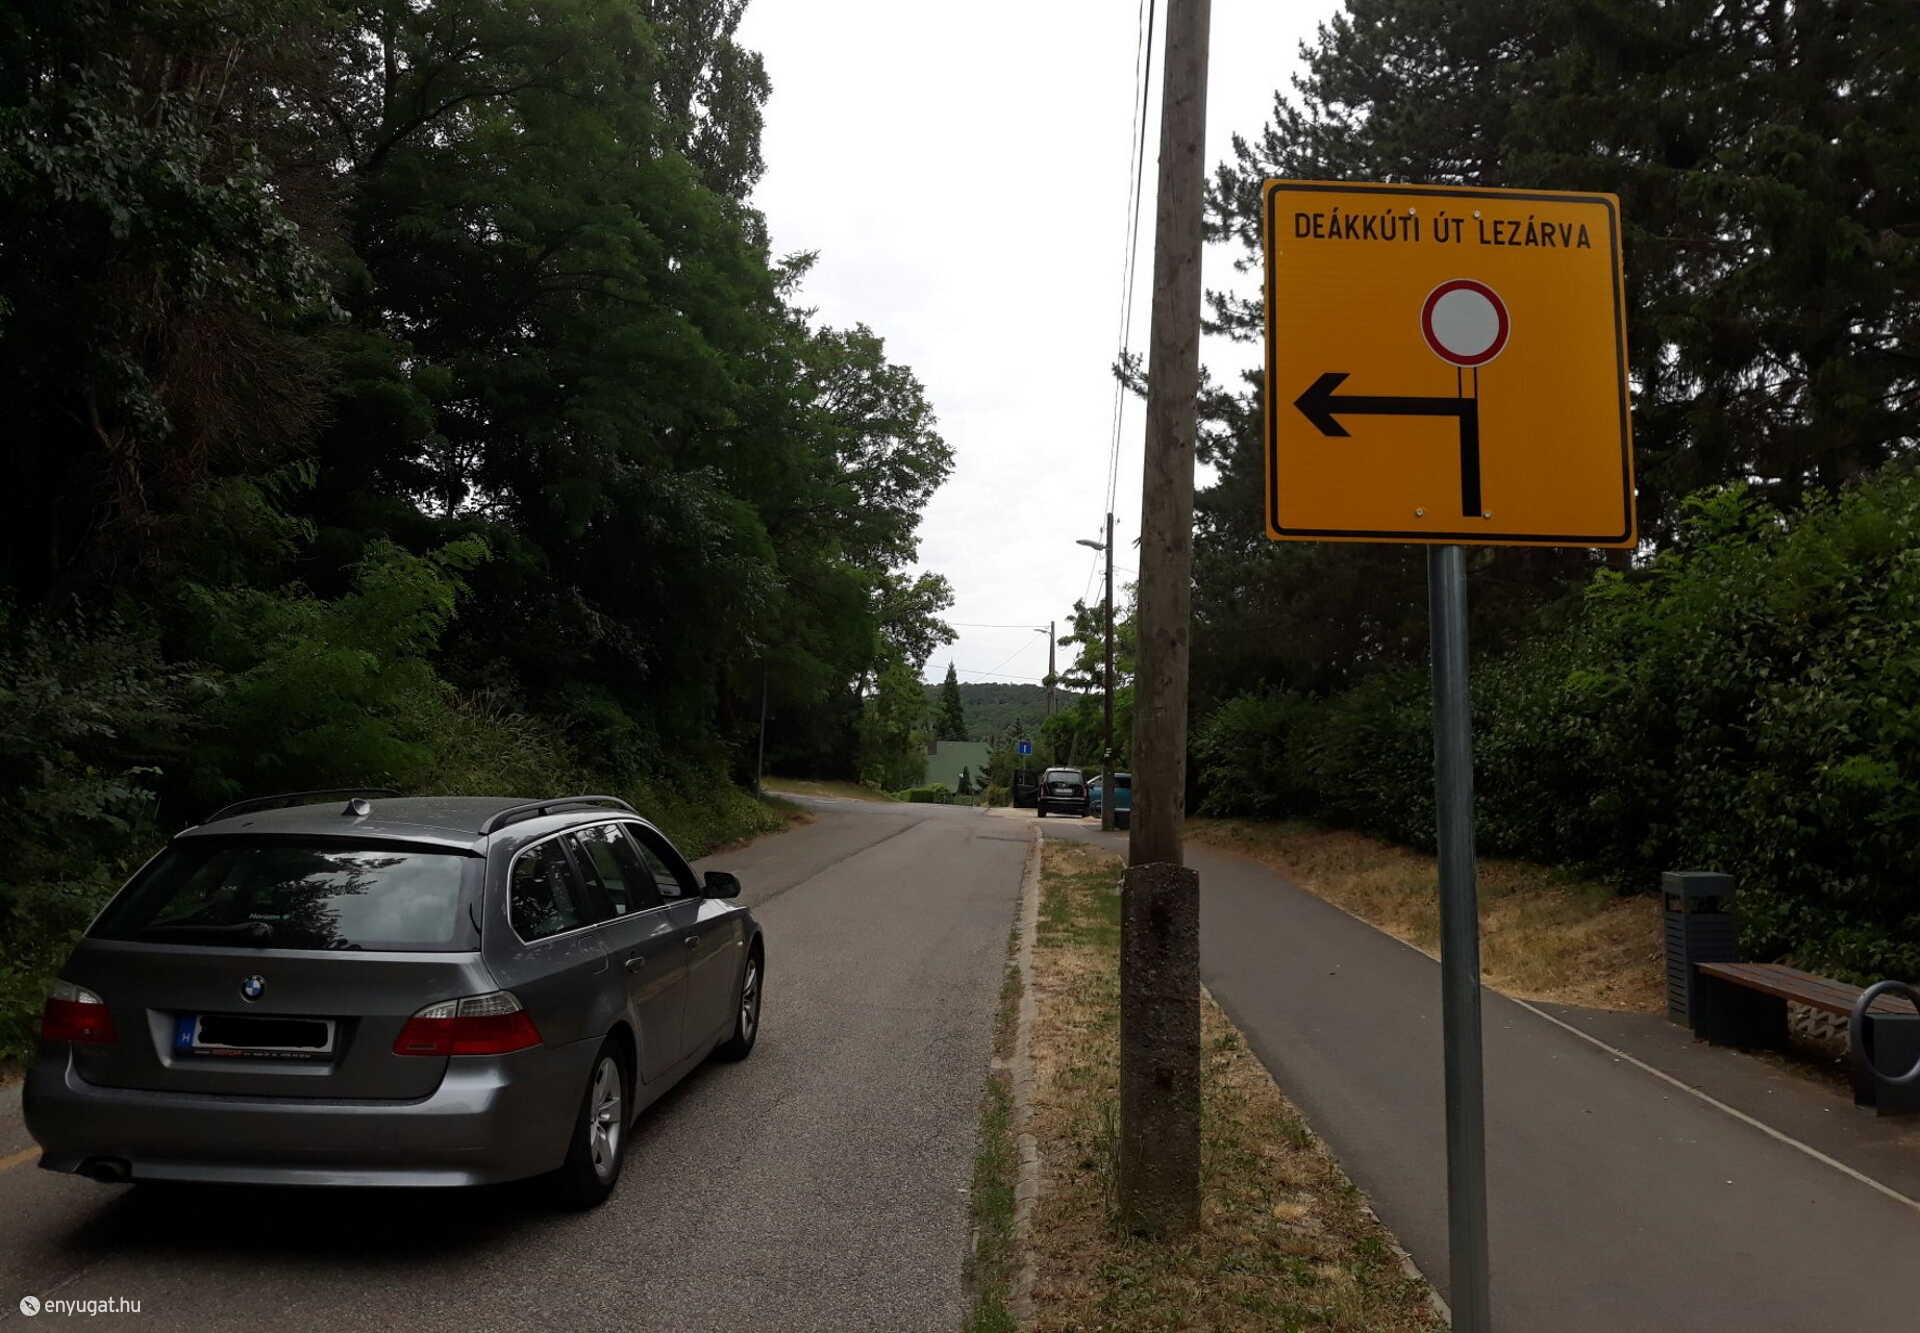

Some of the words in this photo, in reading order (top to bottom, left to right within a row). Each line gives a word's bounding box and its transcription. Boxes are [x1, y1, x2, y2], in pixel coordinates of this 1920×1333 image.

[1294, 207, 1420, 242] DEÁKKÚTI
[1433, 211, 1465, 243] ÚT
[1478, 215, 1591, 249] LEZÁRVA
[181, 1032, 191, 1042] H
